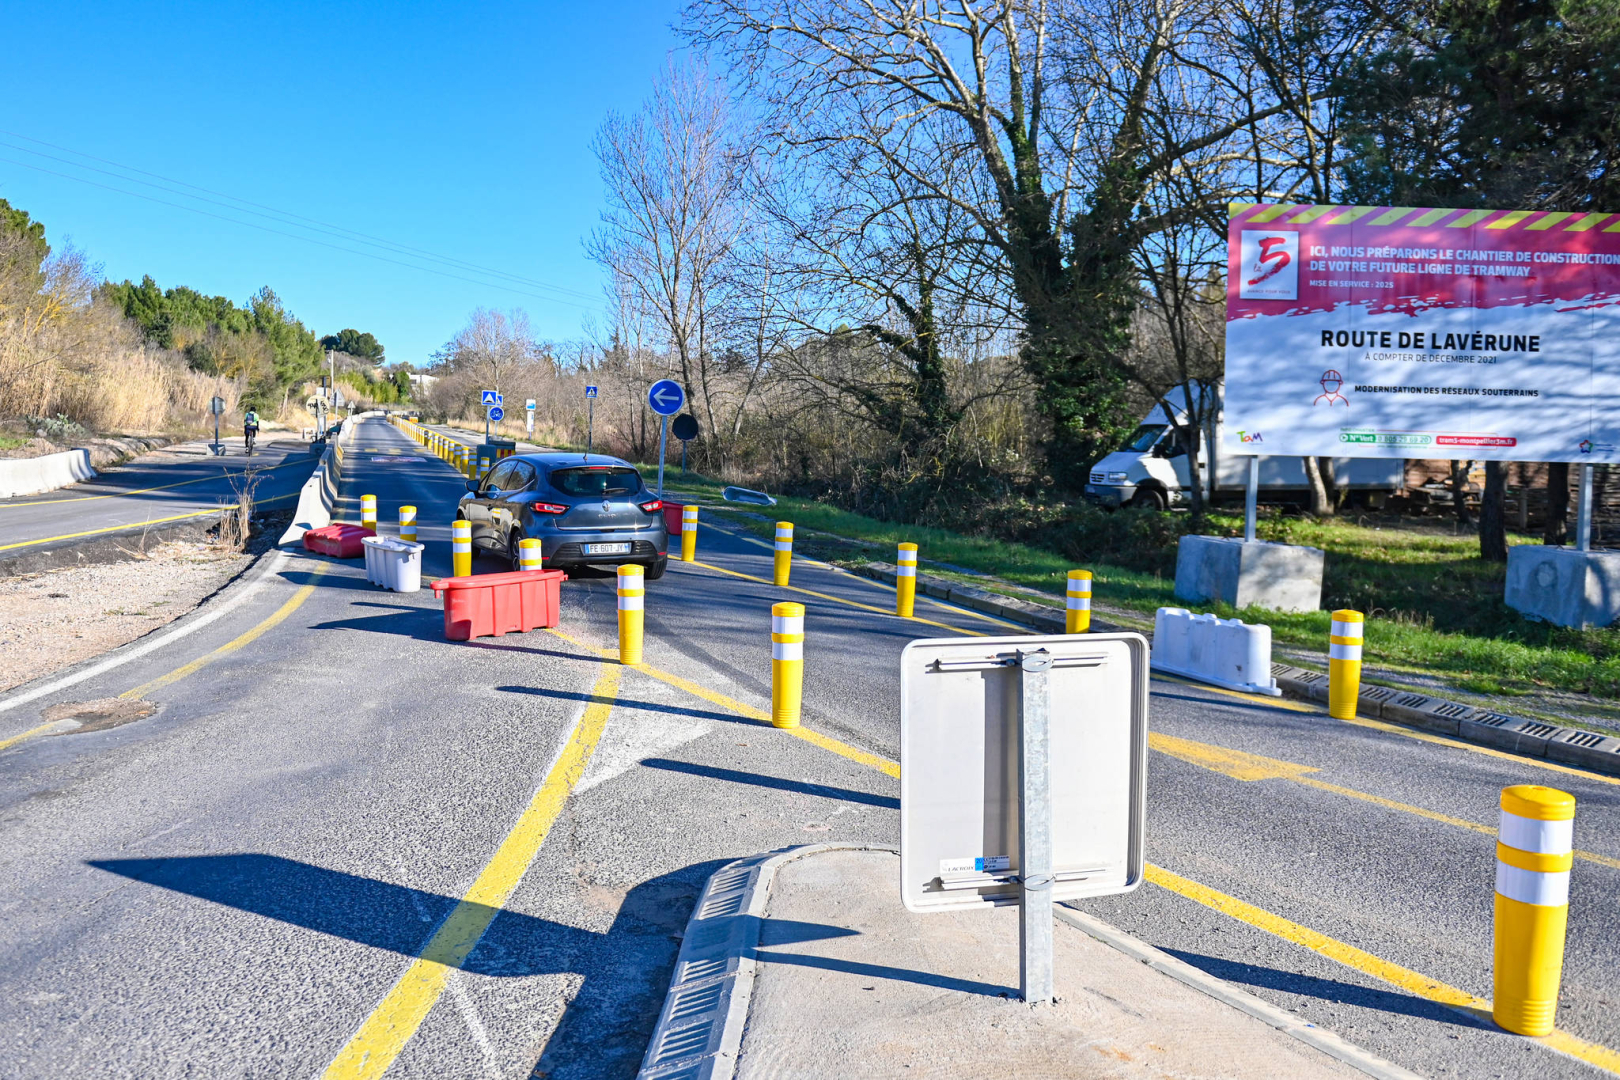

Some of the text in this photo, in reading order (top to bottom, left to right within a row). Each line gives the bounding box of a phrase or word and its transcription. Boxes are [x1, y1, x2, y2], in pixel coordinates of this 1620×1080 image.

[1248, 237, 1291, 285] 5
[1310, 245, 1620, 264] ICI, NOUS PRÉPARONS LE CHANTIER DE CONSTRUCTION
[1310, 261, 1531, 276] DE VOTRE FUTURE LIGNE DE TRAMWAY
[1339, 280, 1370, 288] SERVICE
[1321, 330, 1540, 352] ROUTE DE LAVÉRUNE
[1365, 351, 1370, 360] À
[1373, 353, 1413, 362] COMPTER
[1416, 354, 1427, 362] DE
[1355, 385, 1422, 393] MODERNISATION
[1442, 386, 1480, 396] RÉSEAUX
[1482, 388, 1539, 397] SOUTERRAINS
